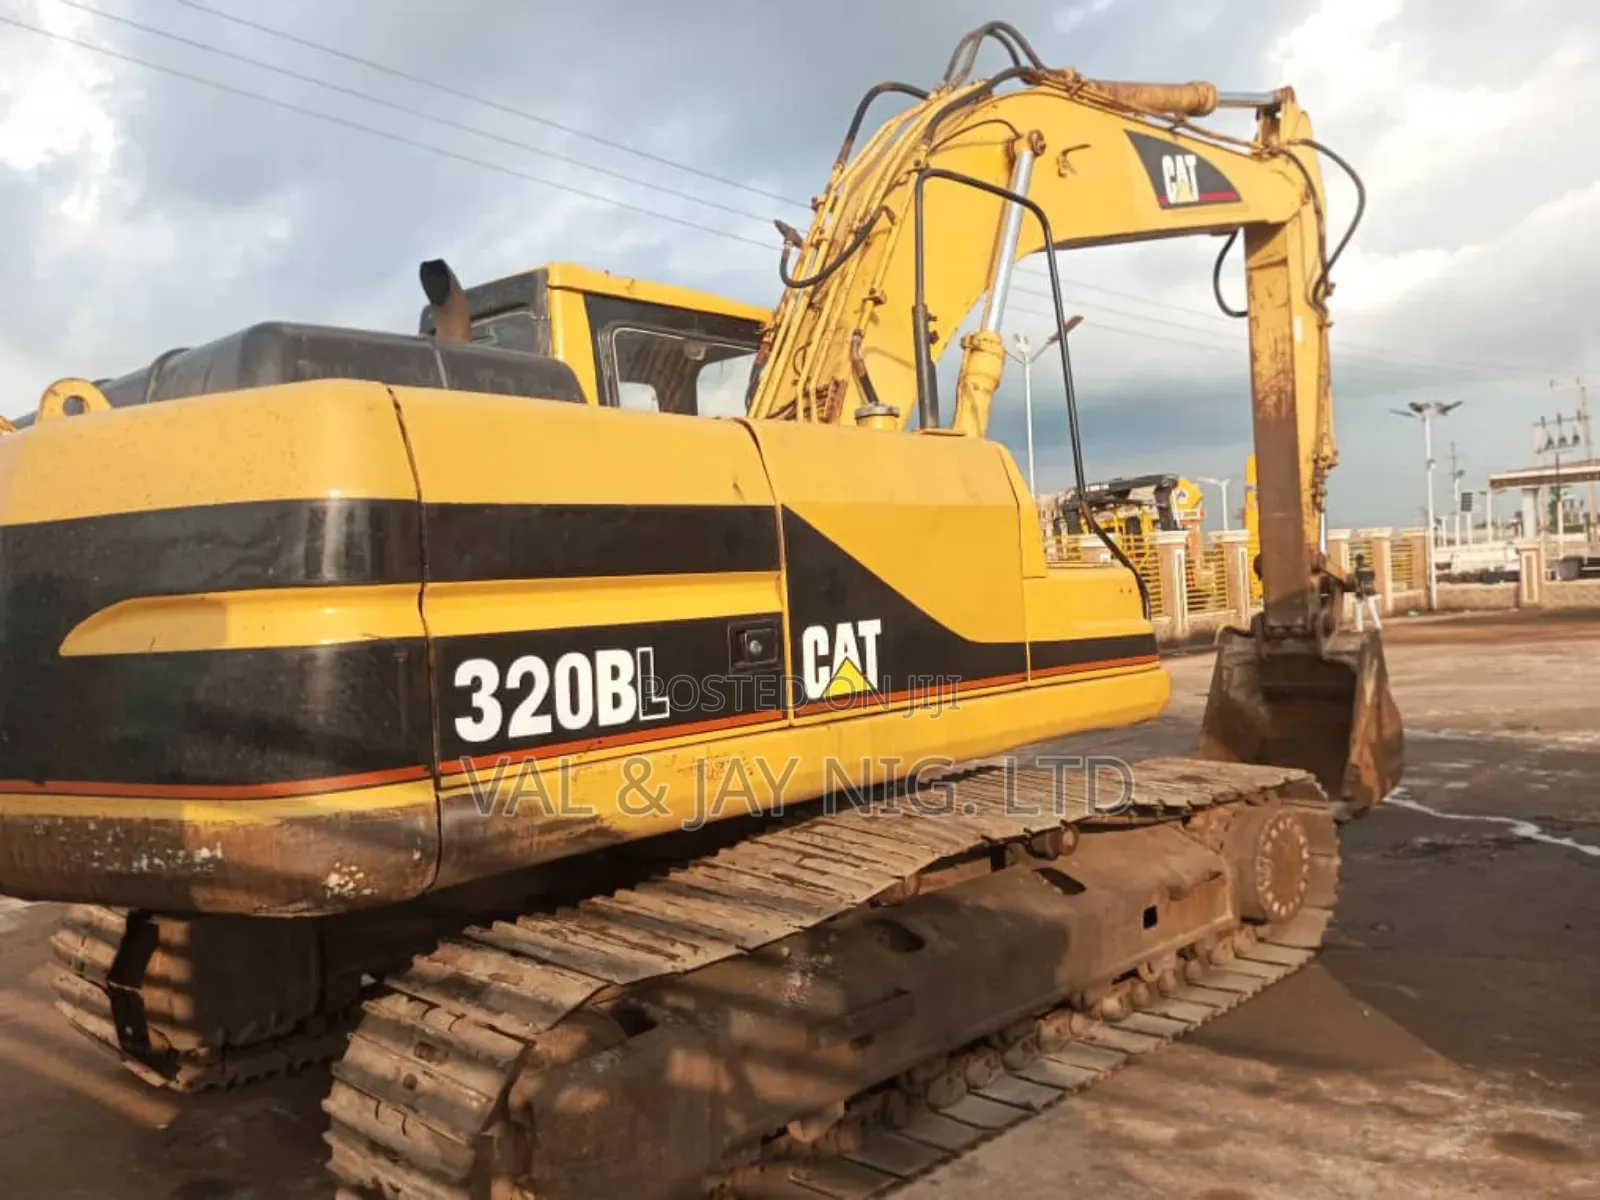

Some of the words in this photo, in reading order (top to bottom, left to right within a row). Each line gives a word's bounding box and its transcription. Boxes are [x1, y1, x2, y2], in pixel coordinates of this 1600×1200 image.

[1161, 154, 1199, 204] CAT
[454, 647, 670, 743] 320BL
[802, 619, 882, 700] CAT
